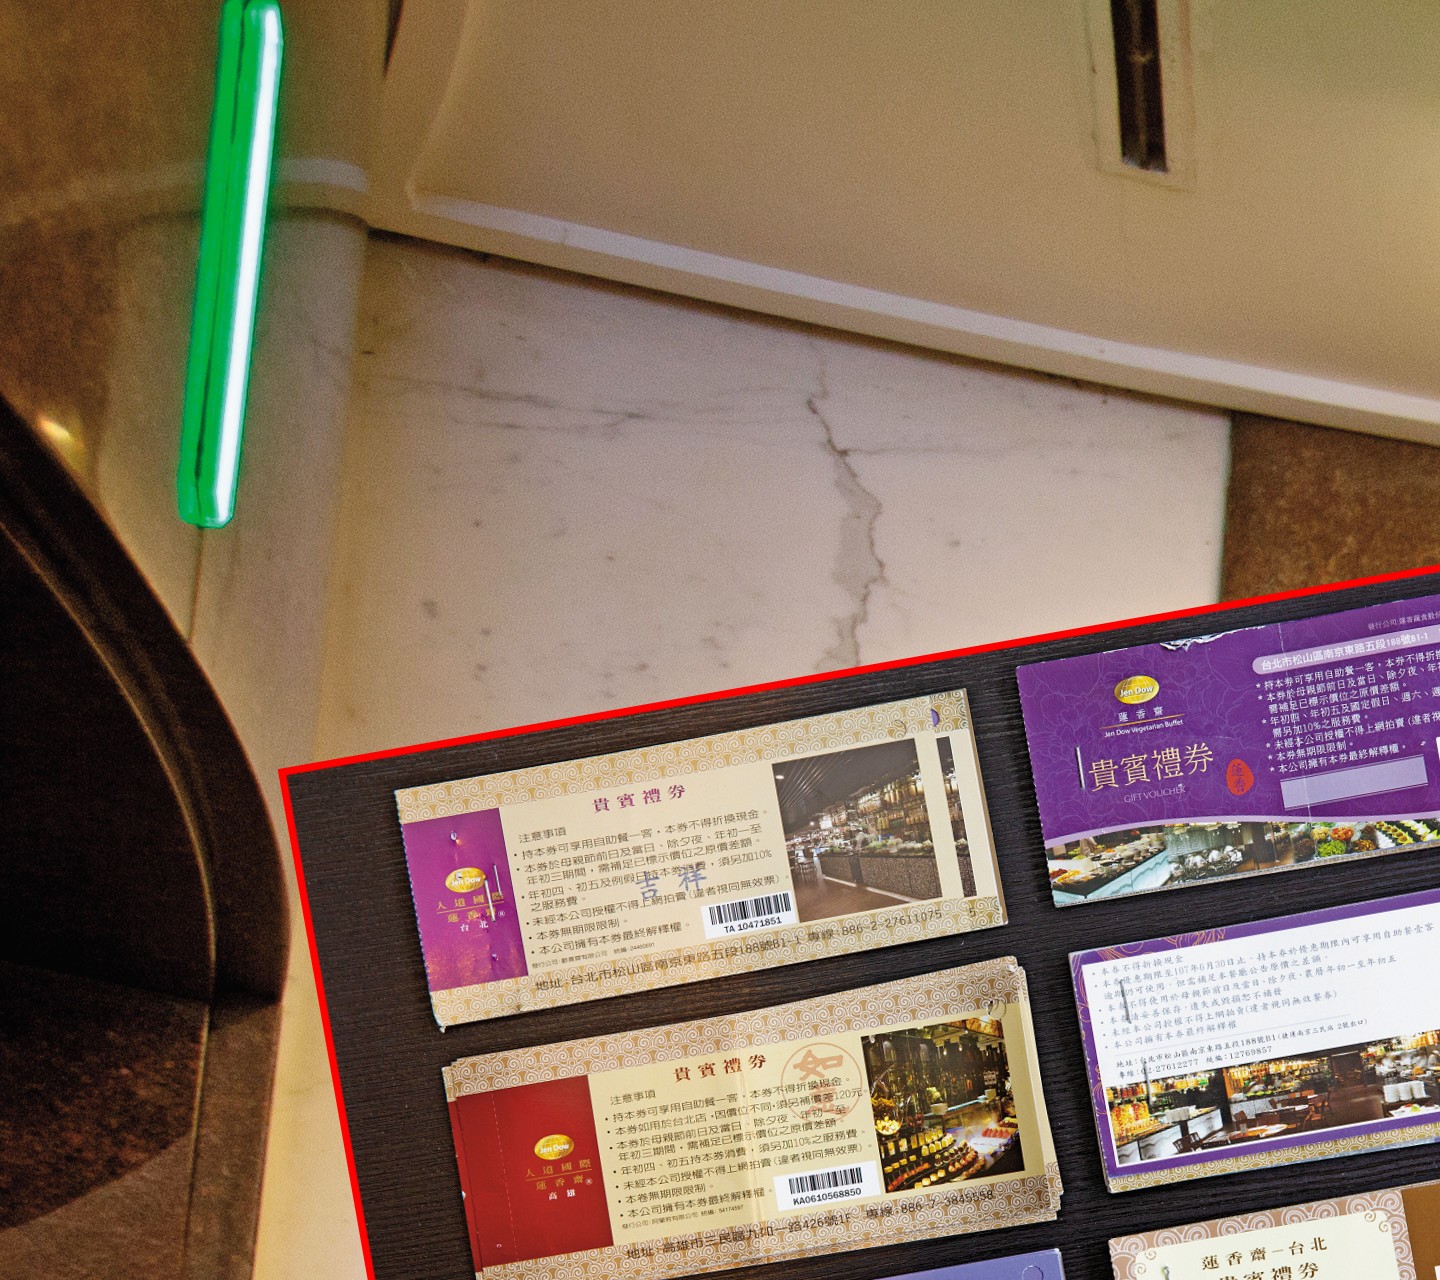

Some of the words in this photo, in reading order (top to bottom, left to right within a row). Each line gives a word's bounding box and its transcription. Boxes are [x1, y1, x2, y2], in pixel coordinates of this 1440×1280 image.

[1118, 687, 1134, 698] Jen
[1134, 684, 1154, 695] Dow
[1103, 729, 1115, 738] Jen
[1115, 727, 1131, 736] Dow
[1130, 721, 1164, 734] Vegetarian
[1164, 718, 1184, 728] Buffet
[1086, 740, 1216, 792] 貴賓禮券
[591, 783, 686, 813] 貴賓禮券
[1122, 791, 1143, 803] GIFT
[518, 826, 568, 844] 注意事項
[465, 874, 481, 884] Dow
[633, 861, 710, 901] 吉祥
[460, 919, 489, 932] 台北
[724, 924, 736, 933] TA
[736, 915, 783, 931] 10471851
[672, 1053, 767, 1083] 貴賓禮券
[609, 1089, 657, 1105] 注意事項
[538, 1144, 552, 1154] Jen
[552, 1141, 570, 1152] Dow
[524, 1158, 592, 1178] 人道國際
[547, 1188, 576, 1201] 高雄
[792, 1187, 862, 1206] KA0610568850
